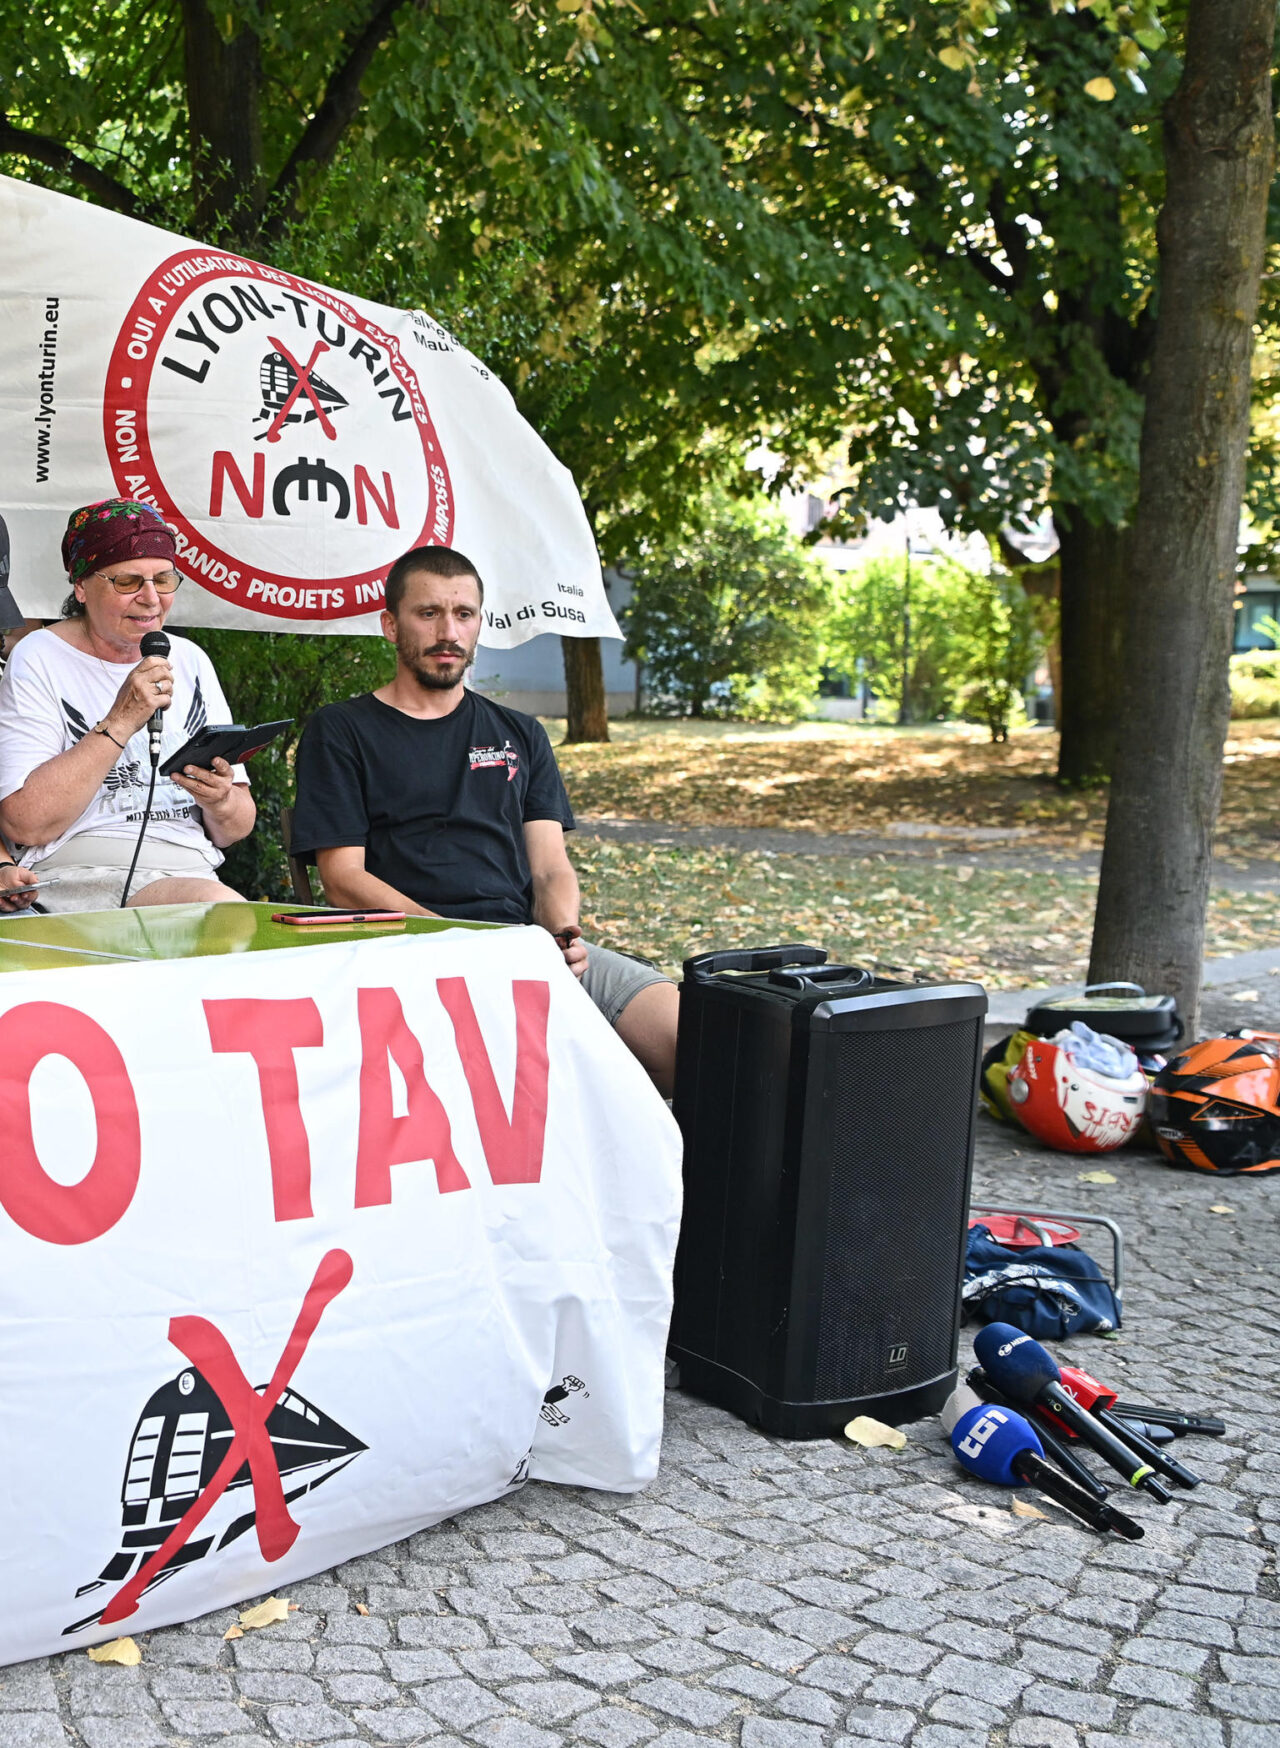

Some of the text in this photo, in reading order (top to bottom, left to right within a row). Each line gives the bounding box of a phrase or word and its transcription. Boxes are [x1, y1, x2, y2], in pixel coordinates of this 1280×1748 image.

[35, 297, 60, 483] www.lyonturin.eu
[127, 316, 157, 360] OUI
[147, 296, 168, 316] A
[158, 256, 255, 297] L'UTILISATION
[256, 266, 291, 286] DES
[296, 282, 358, 324] LIGNES
[365, 322, 429, 425] EXISTANTES
[161, 284, 414, 422] LYON-TURIN
[115, 409, 140, 463] NON
[246, 577, 345, 609] PROJETS
[432, 464, 449, 543] IMPOSÉS
[484, 601, 586, 629] Val di Susa
[557, 582, 584, 597] Italia
[202, 976, 551, 1223] TAV
